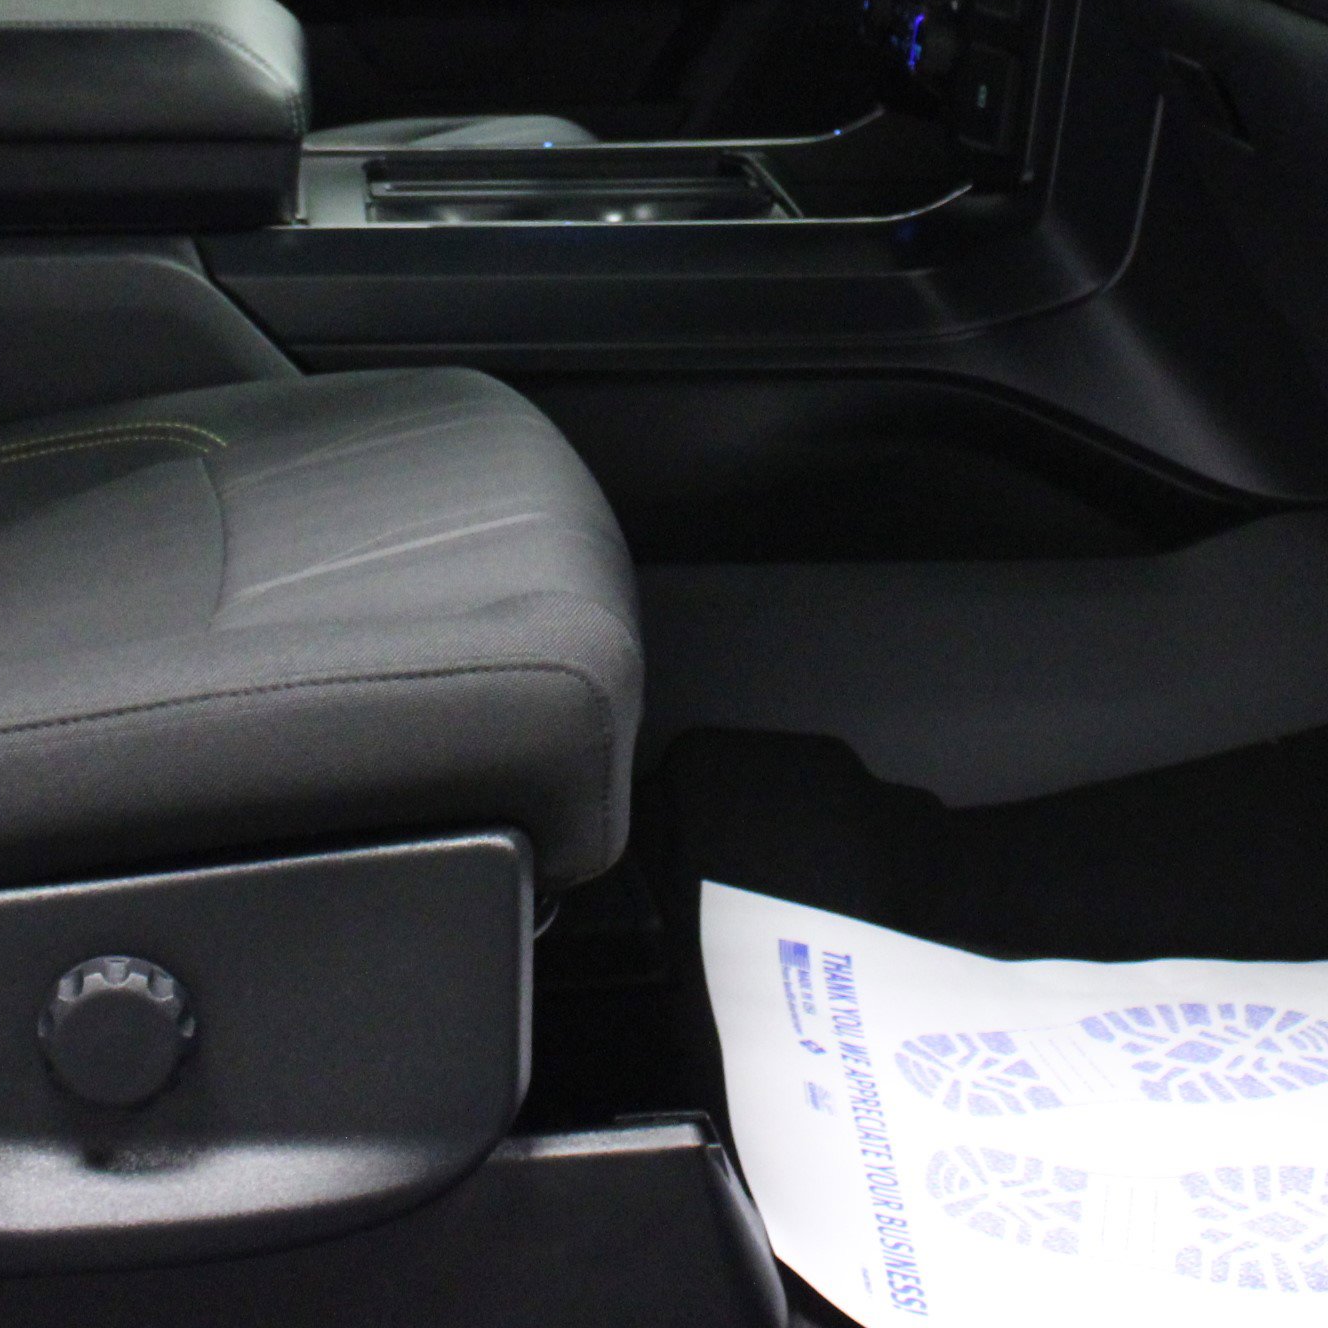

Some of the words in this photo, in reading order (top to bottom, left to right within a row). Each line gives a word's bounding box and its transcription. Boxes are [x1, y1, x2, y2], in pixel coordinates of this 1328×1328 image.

[822, 951, 857, 1004] THANK
[837, 1040, 872, 1067] WE
[845, 1066, 893, 1160] APPRECIATE
[865, 1163, 904, 1212] YOUR
[875, 1213, 927, 1316] BUSINESS!
